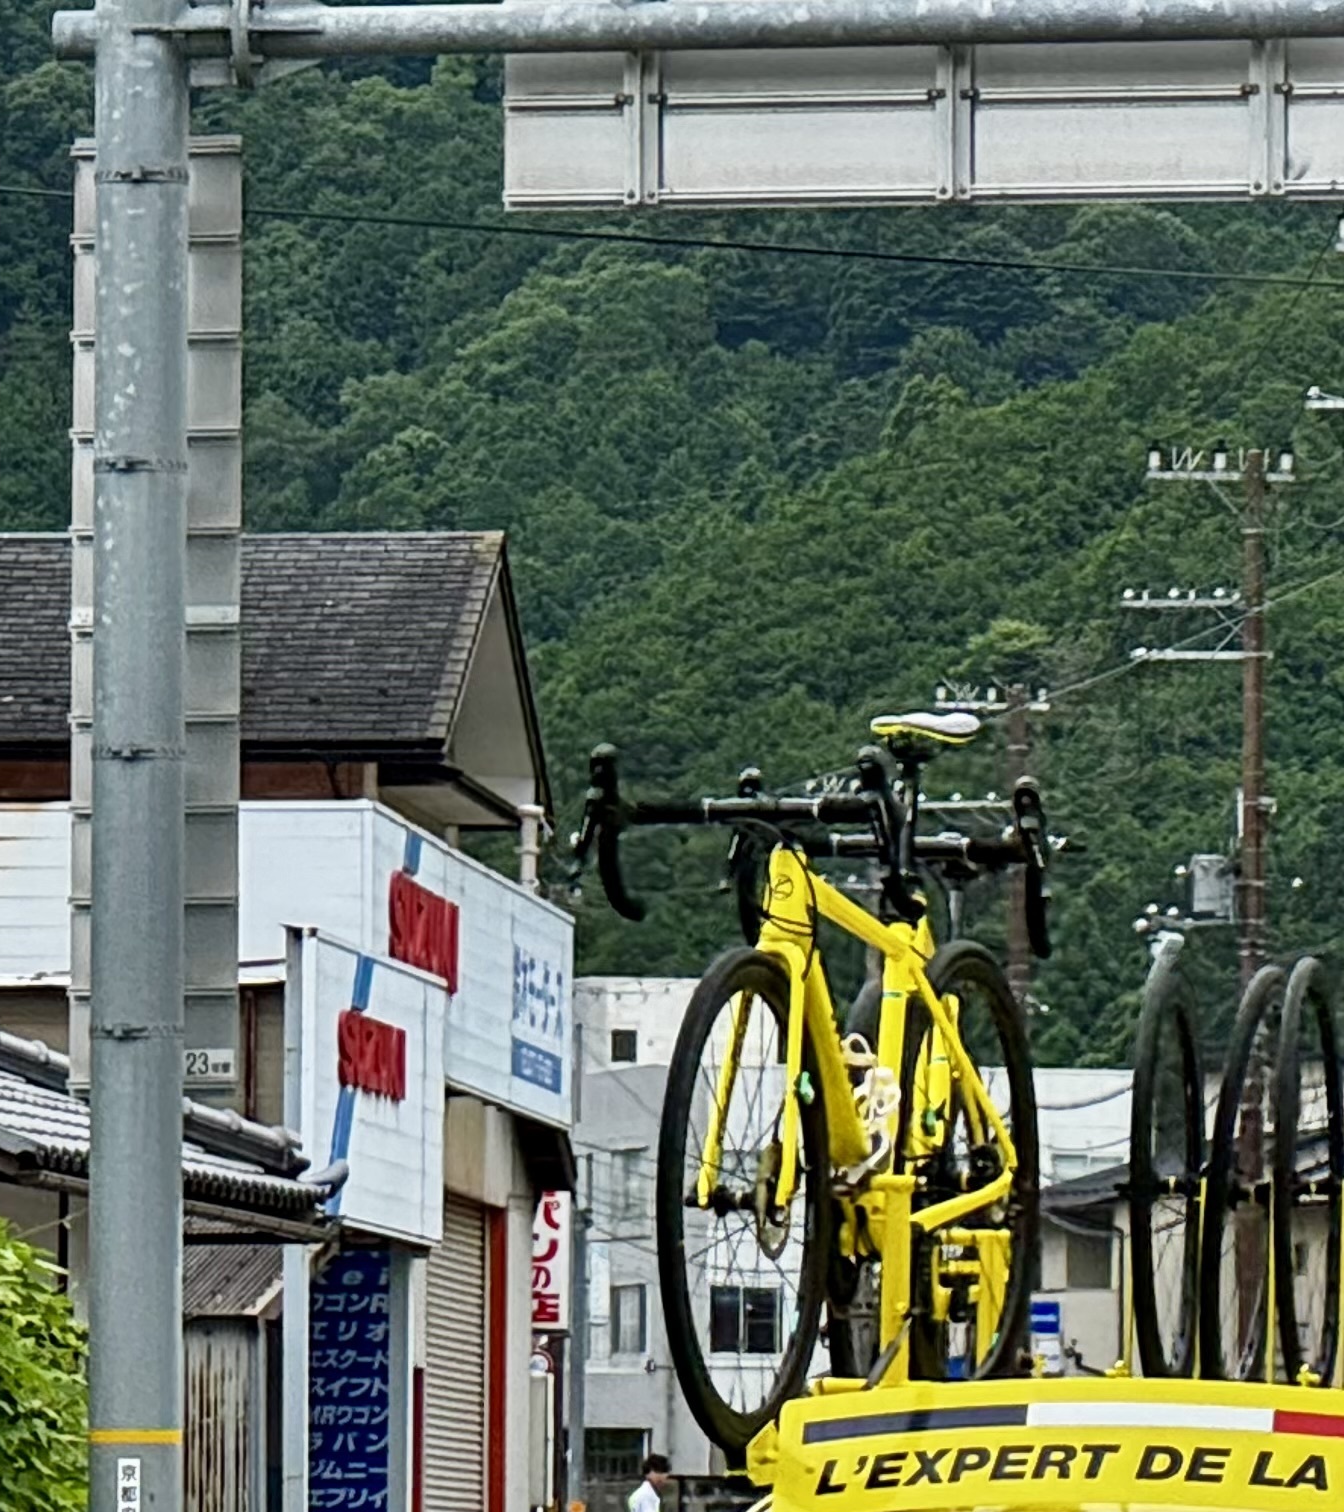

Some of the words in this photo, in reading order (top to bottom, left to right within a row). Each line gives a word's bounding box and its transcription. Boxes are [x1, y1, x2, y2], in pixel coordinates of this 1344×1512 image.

[814, 1444, 1121, 1495] L'EXPERT
[1135, 1445, 1232, 1483] DE
[1248, 1451, 1329, 1490] LA
